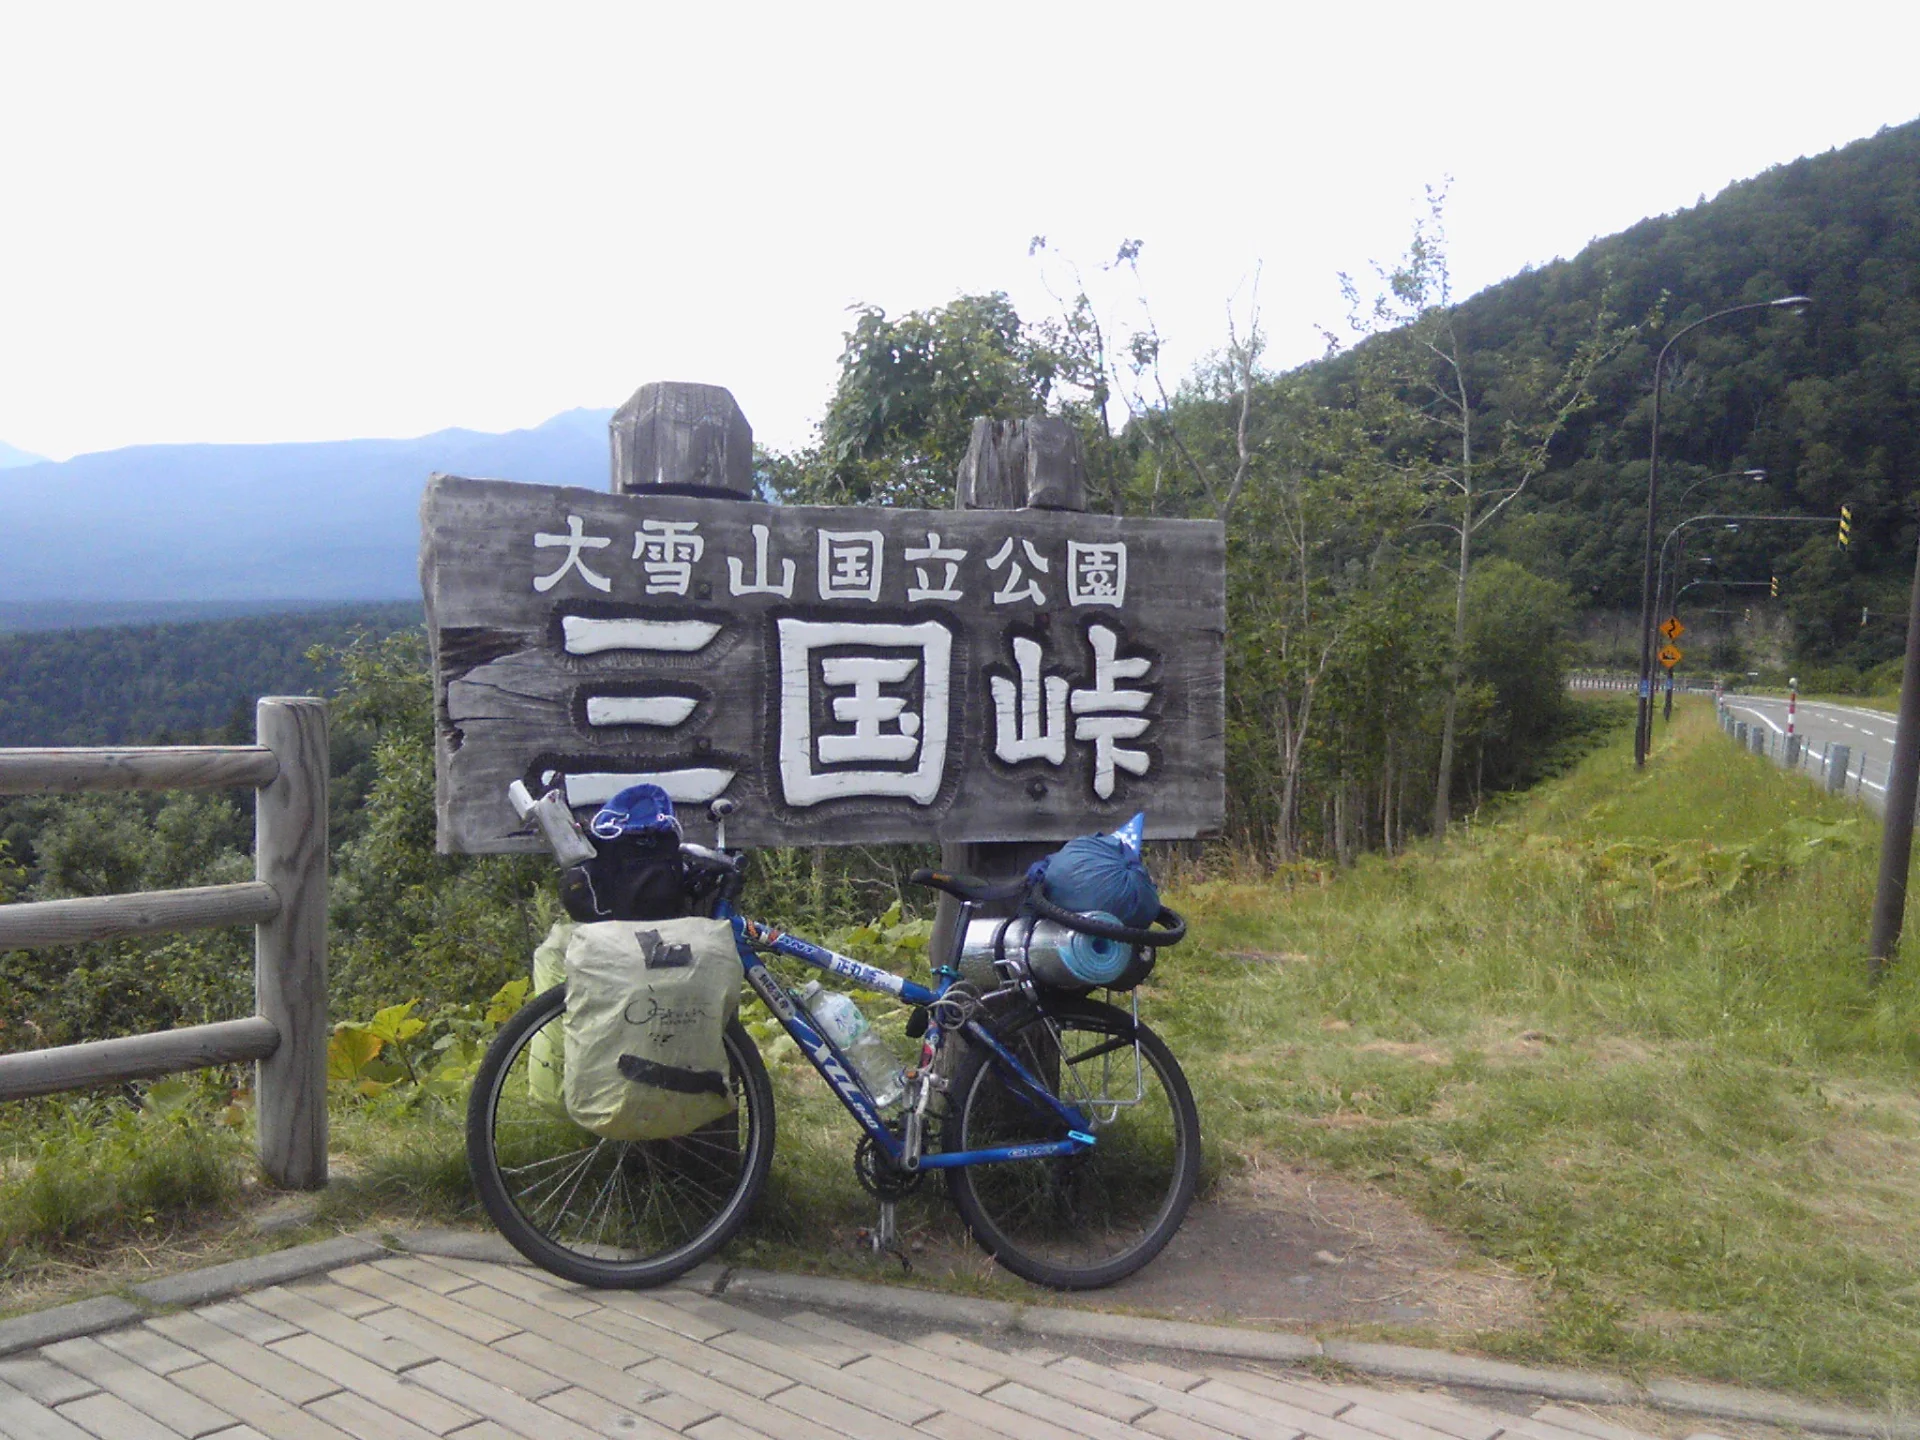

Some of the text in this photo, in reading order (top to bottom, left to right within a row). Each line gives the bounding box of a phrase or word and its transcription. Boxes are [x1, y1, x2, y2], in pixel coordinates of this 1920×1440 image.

[533, 514, 1127, 608] 大雪山国立公園
[541, 616, 1154, 807] 三国峠
